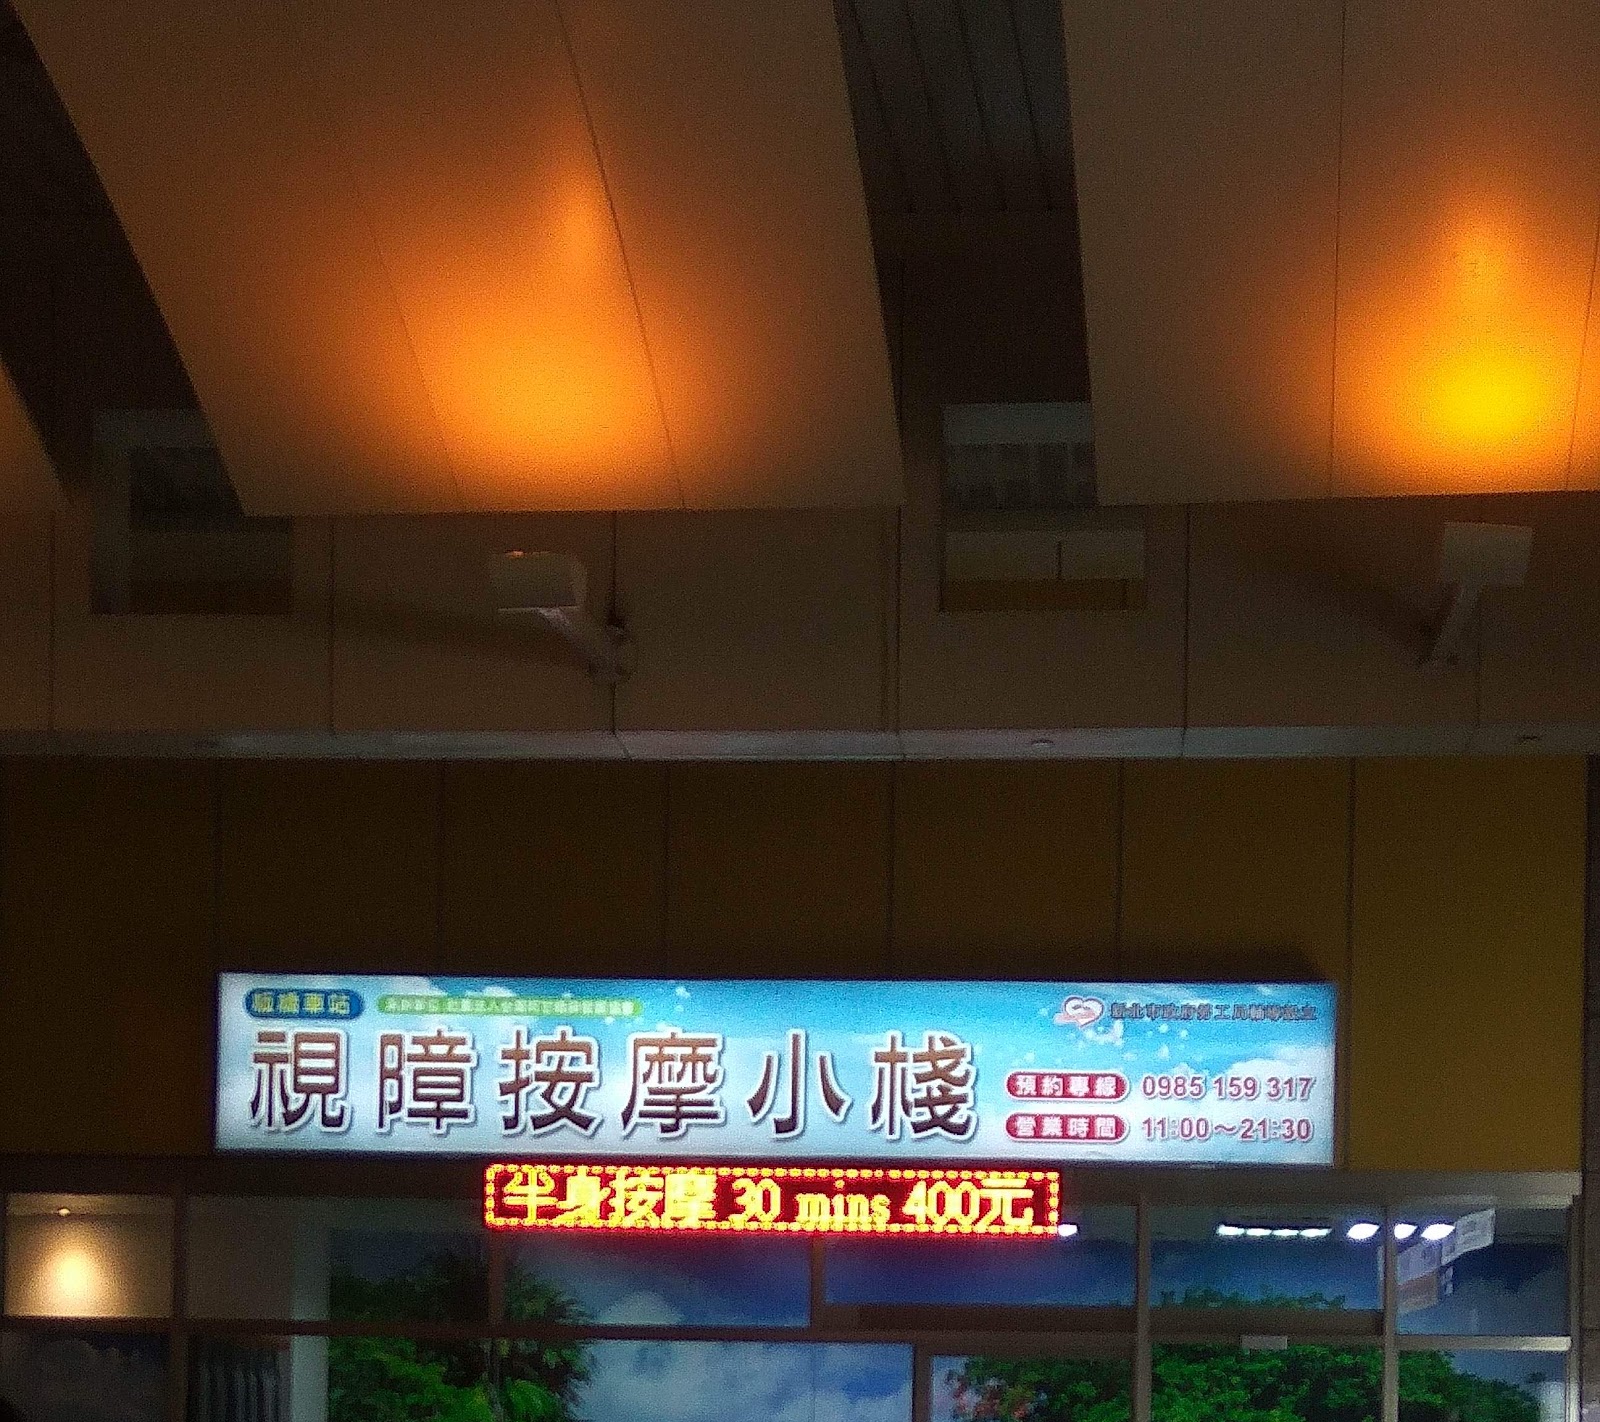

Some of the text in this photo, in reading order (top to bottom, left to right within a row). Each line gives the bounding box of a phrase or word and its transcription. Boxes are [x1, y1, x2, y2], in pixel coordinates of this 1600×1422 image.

[249, 1028, 978, 1137] 視障按摩小棧
[1014, 1075, 1119, 1097] 預約專線
[1142, 1076, 1314, 1098] 0985 159 317
[1014, 1116, 1117, 1138] 營業時間
[503, 1166, 1034, 1232] 半身按摩 30 mins 400元
